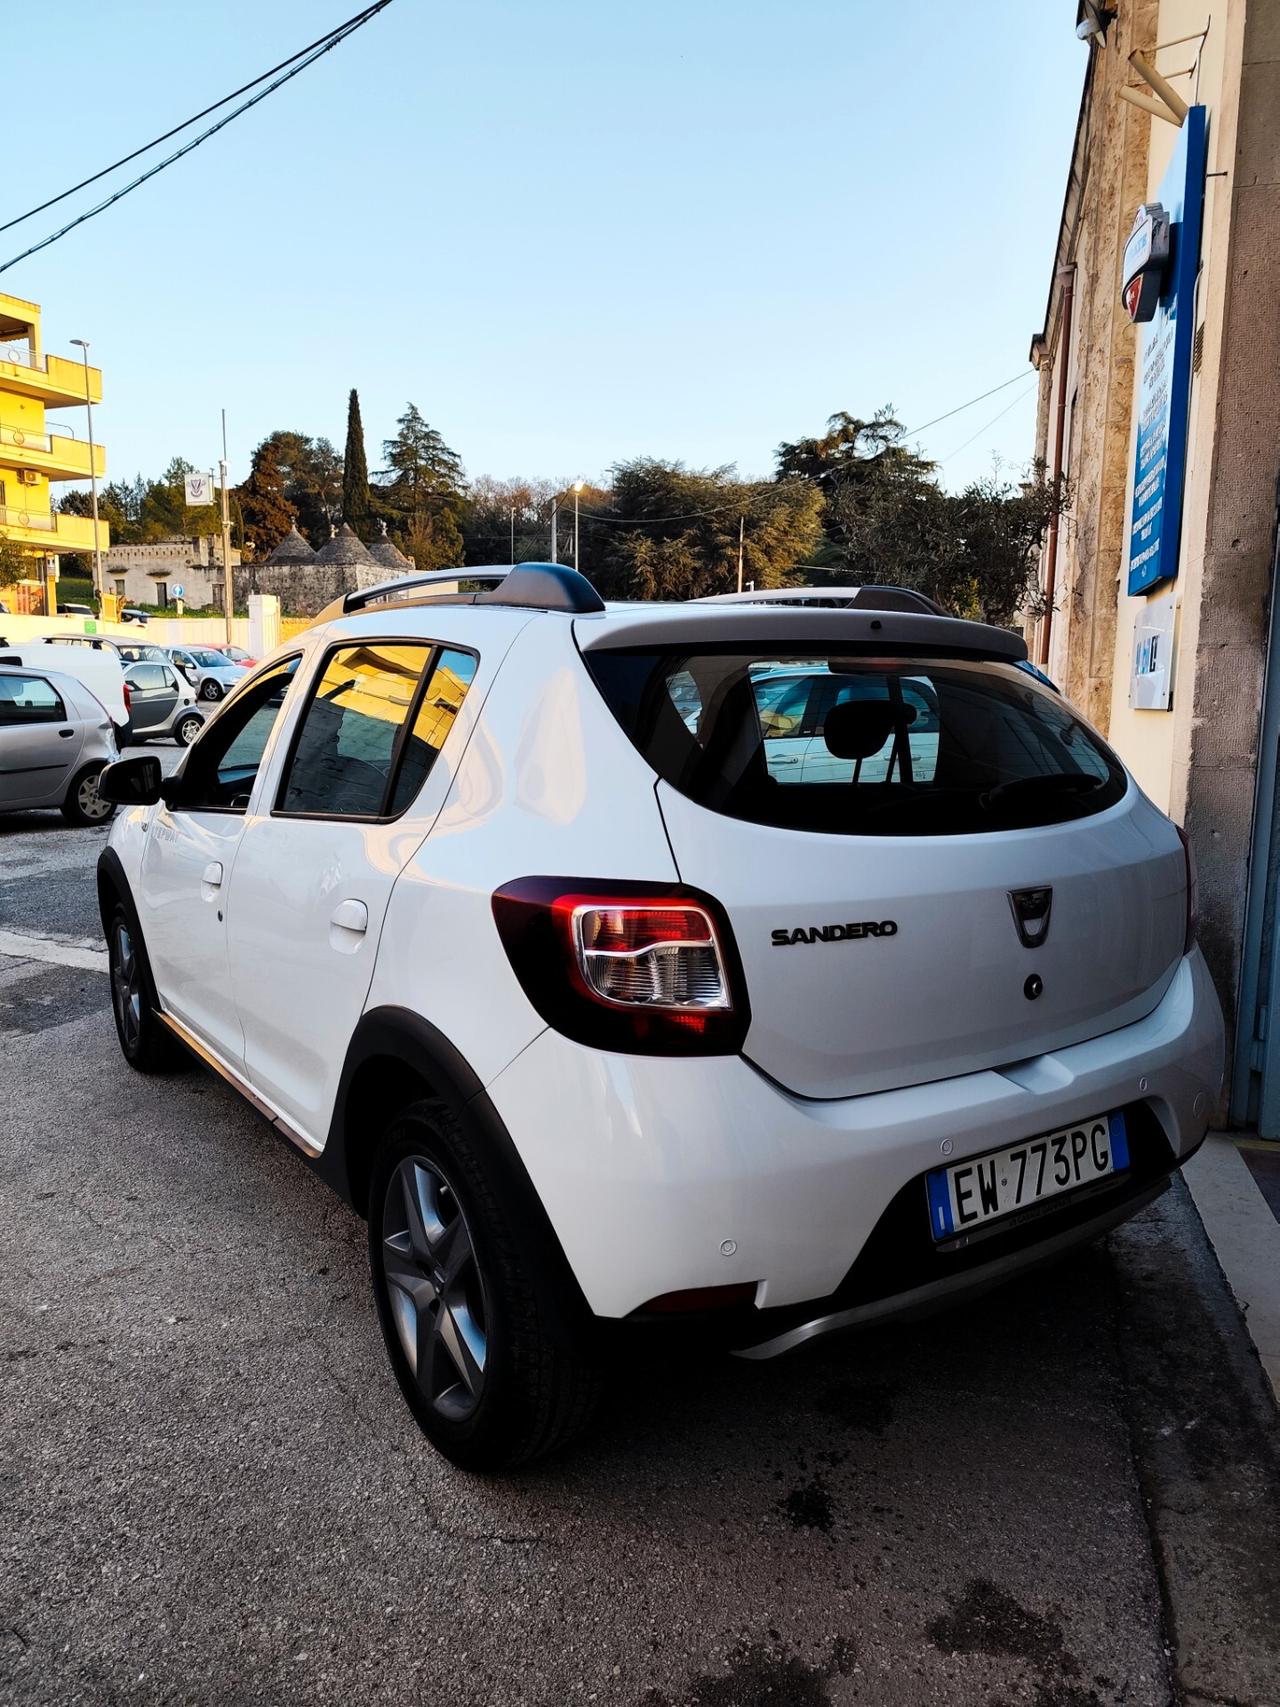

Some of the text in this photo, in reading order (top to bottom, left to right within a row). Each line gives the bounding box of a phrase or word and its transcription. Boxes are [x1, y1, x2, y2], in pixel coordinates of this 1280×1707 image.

[771, 920, 898, 946] SANDERO
[953, 1159, 999, 1225] EW
[1009, 1123, 1109, 1205] 773PG
